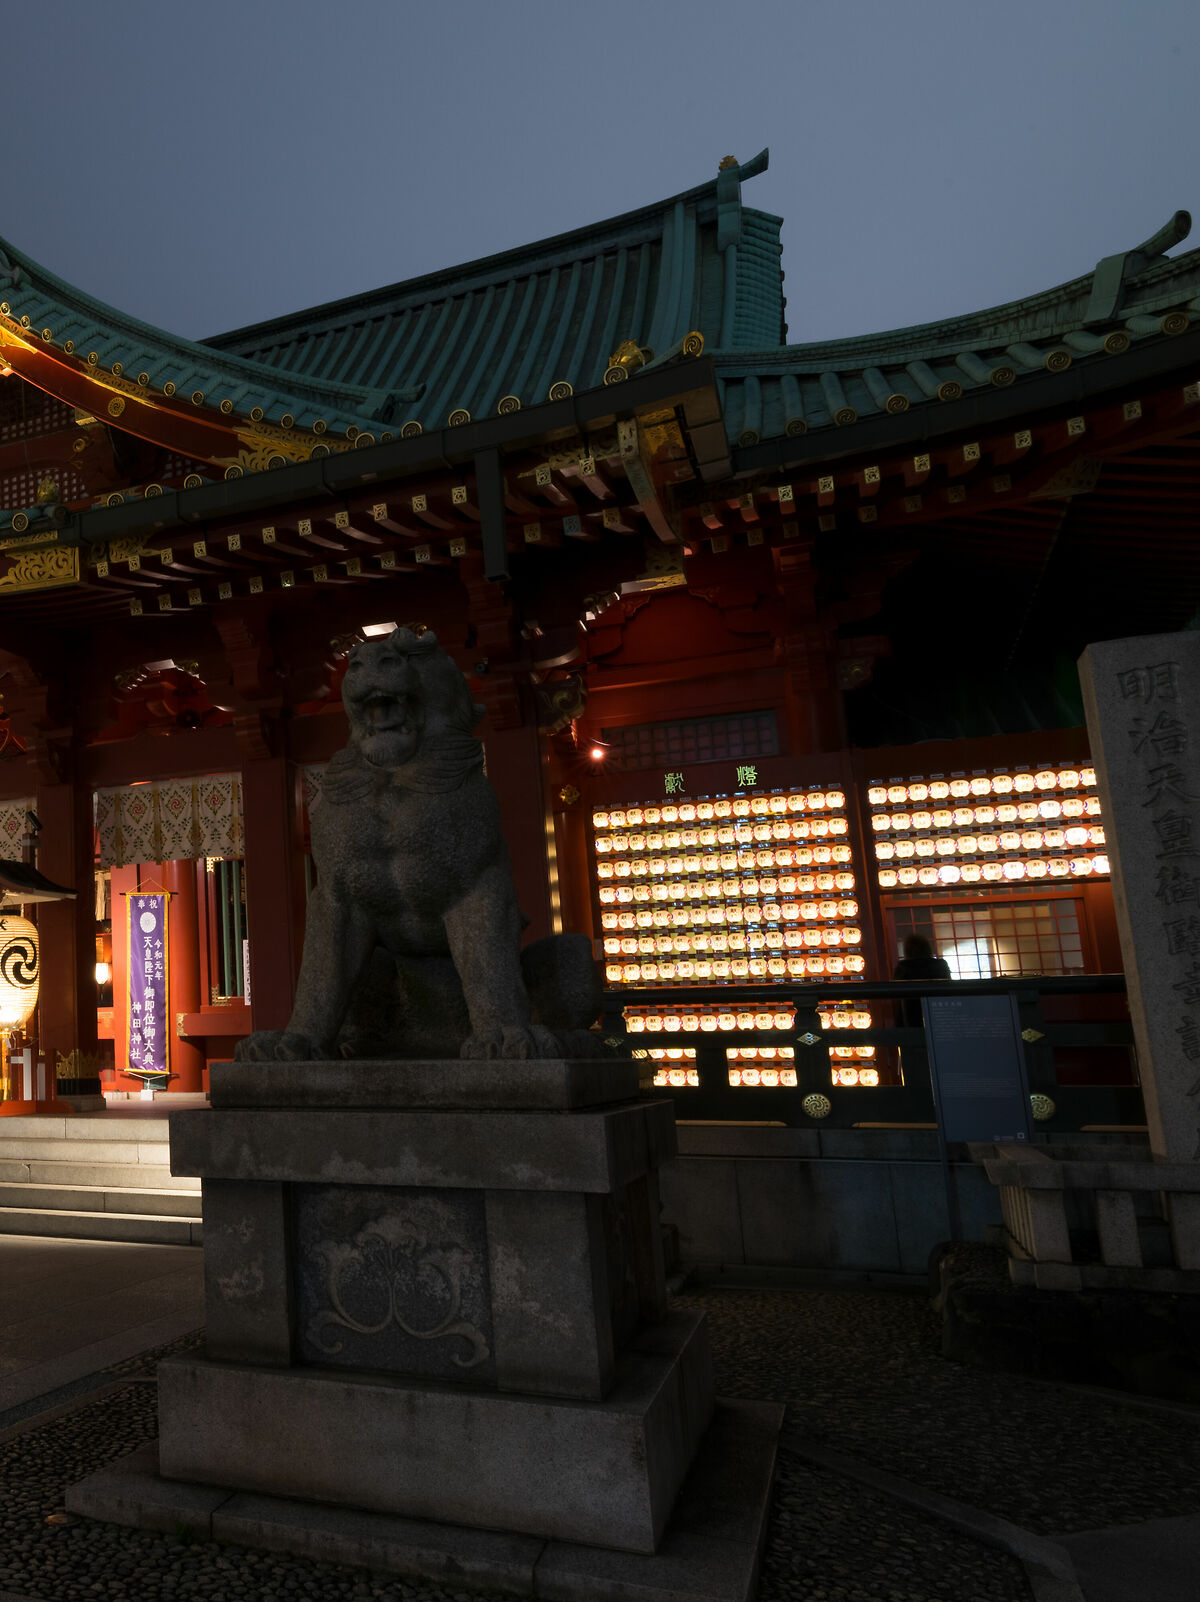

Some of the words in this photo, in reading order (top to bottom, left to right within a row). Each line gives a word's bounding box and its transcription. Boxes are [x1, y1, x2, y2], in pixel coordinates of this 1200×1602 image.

[138, 899, 158, 910] 奉祝
[154, 939, 163, 981] 令和元年
[143, 936, 156, 1066] 天皇陛下御即位御大典
[130, 1001, 142, 1060] 神田神社
